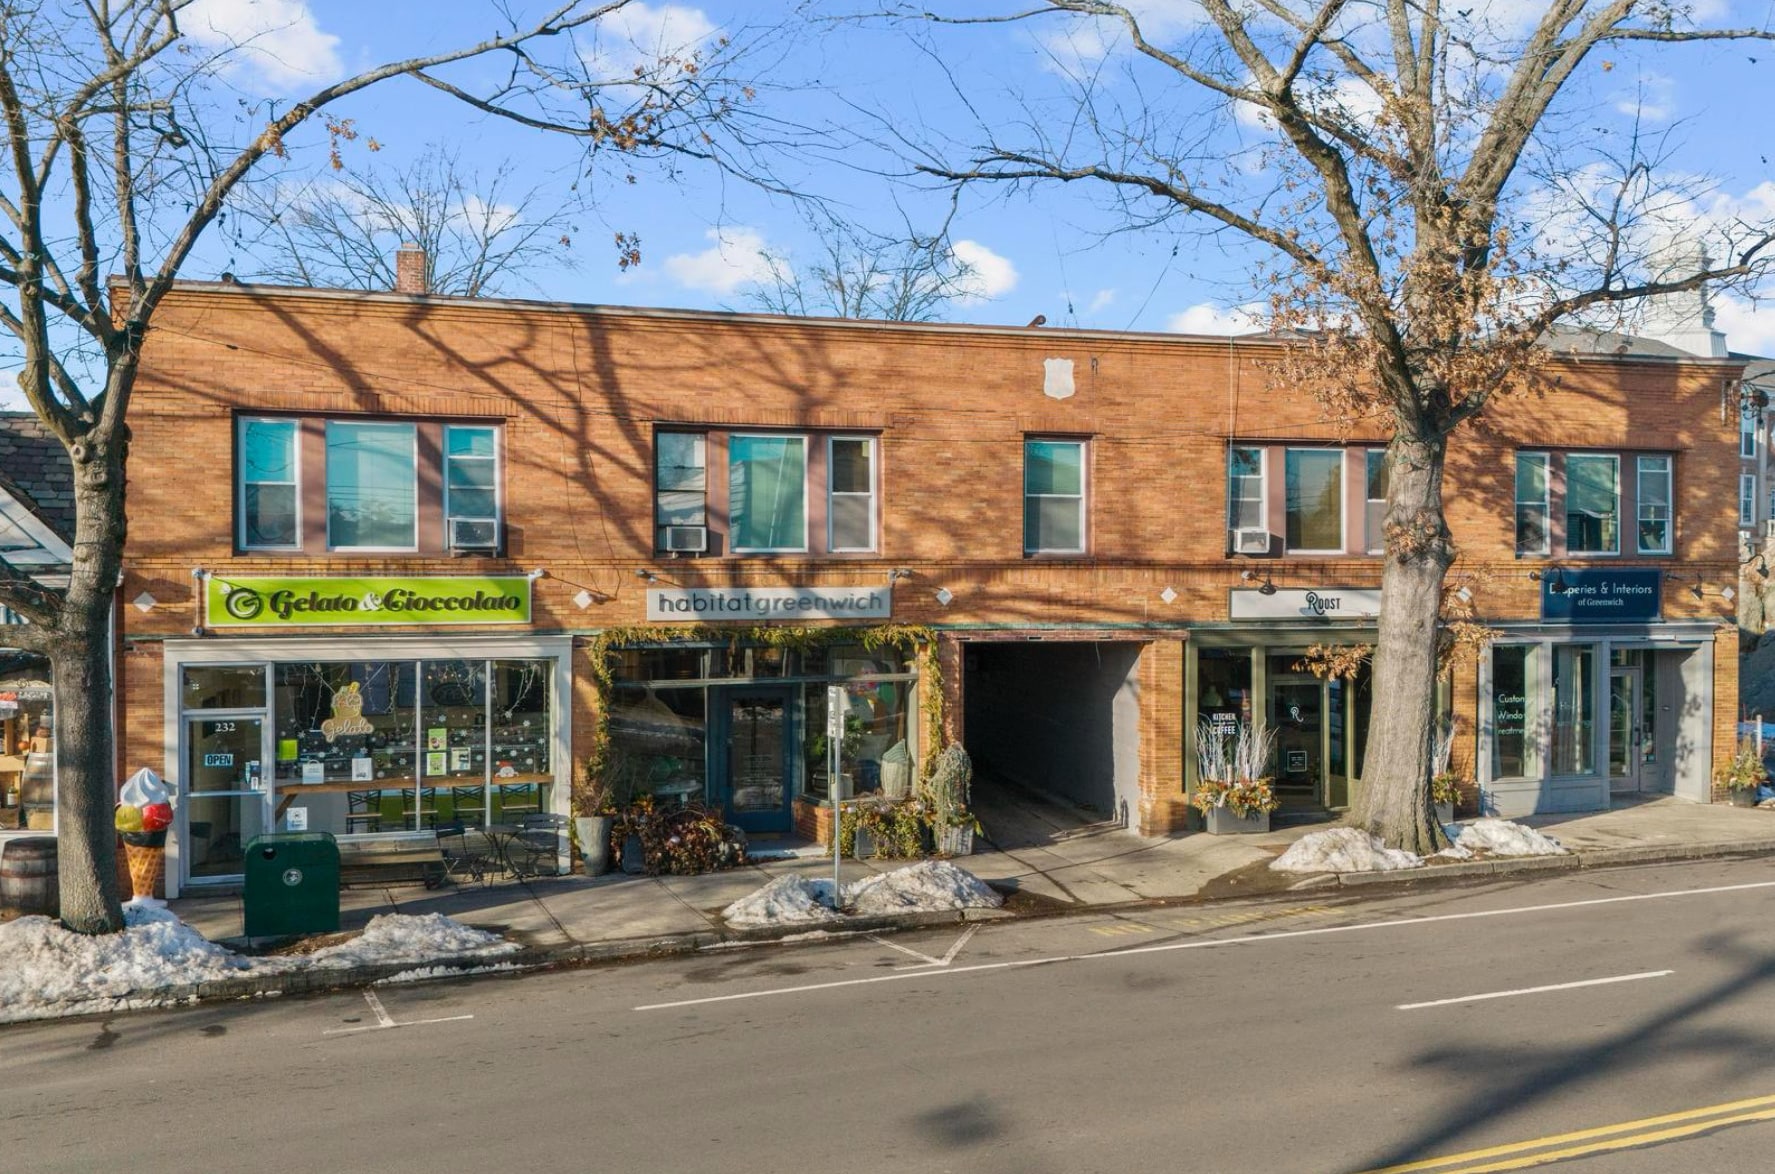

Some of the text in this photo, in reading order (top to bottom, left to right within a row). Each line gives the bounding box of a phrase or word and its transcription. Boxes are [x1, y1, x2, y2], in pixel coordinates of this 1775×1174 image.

[1613, 582, 1652, 594] Interiors
[1578, 598, 1624, 606] of Greenwich
[215, 722, 236, 732] 232
[207, 755, 231, 765] OPEN
